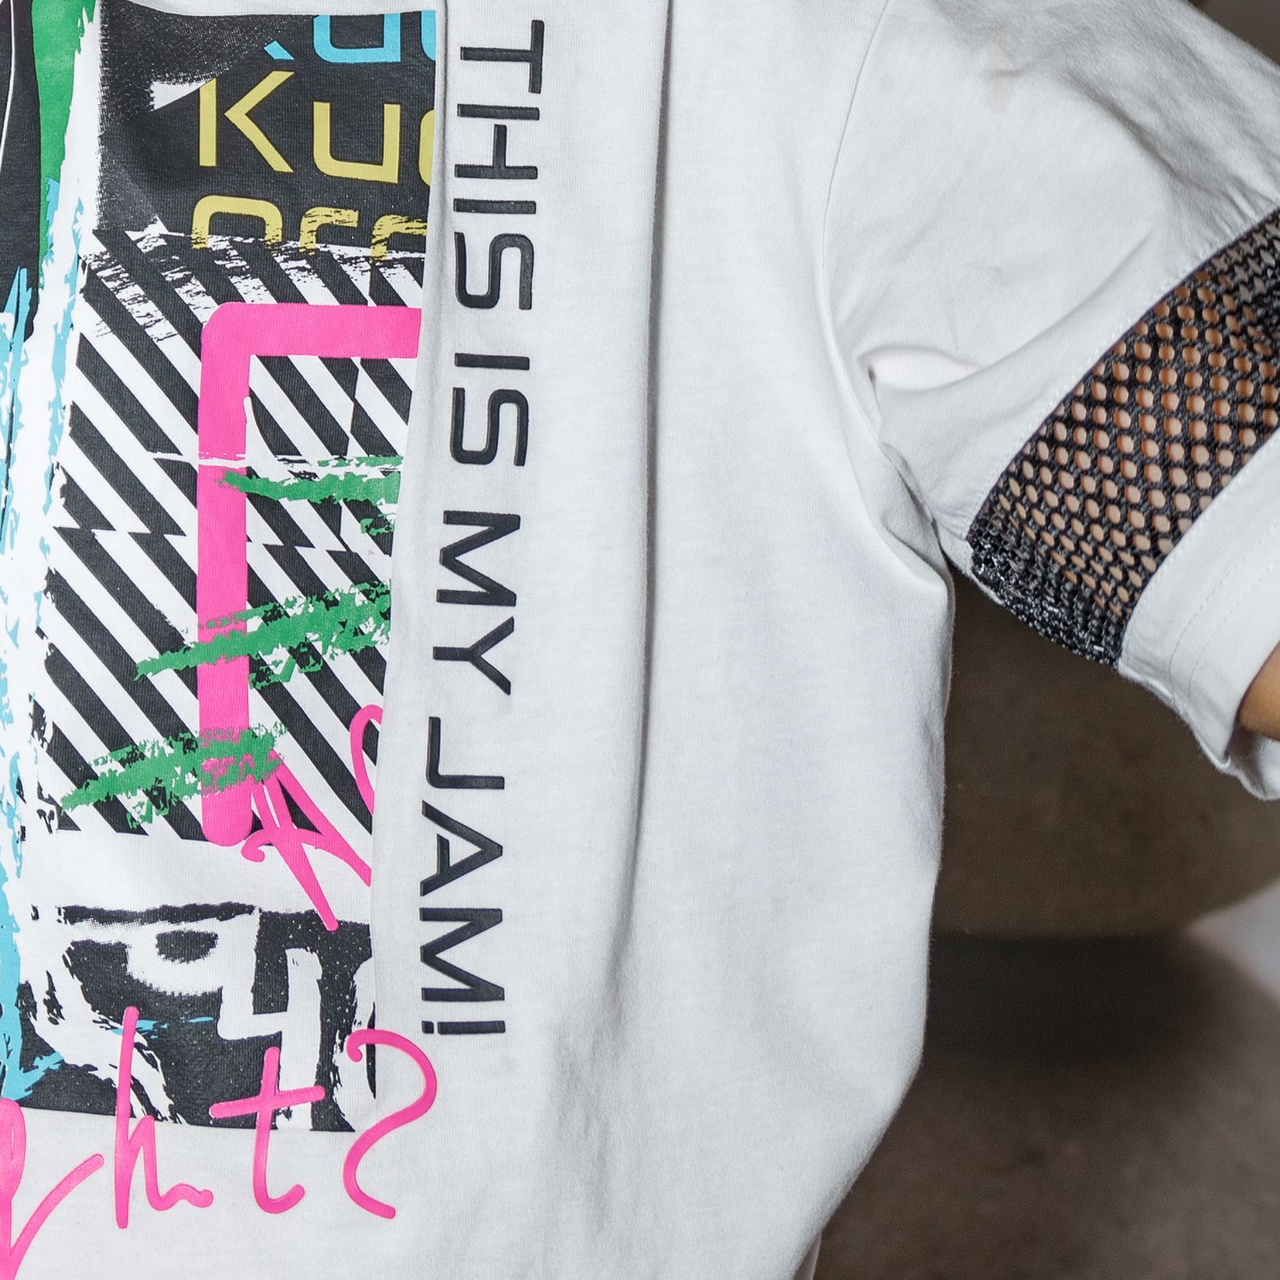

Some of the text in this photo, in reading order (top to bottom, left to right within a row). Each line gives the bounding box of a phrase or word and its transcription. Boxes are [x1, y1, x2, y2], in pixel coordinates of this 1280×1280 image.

[419, 19, 546, 1037] THIS IS MY JAM!
